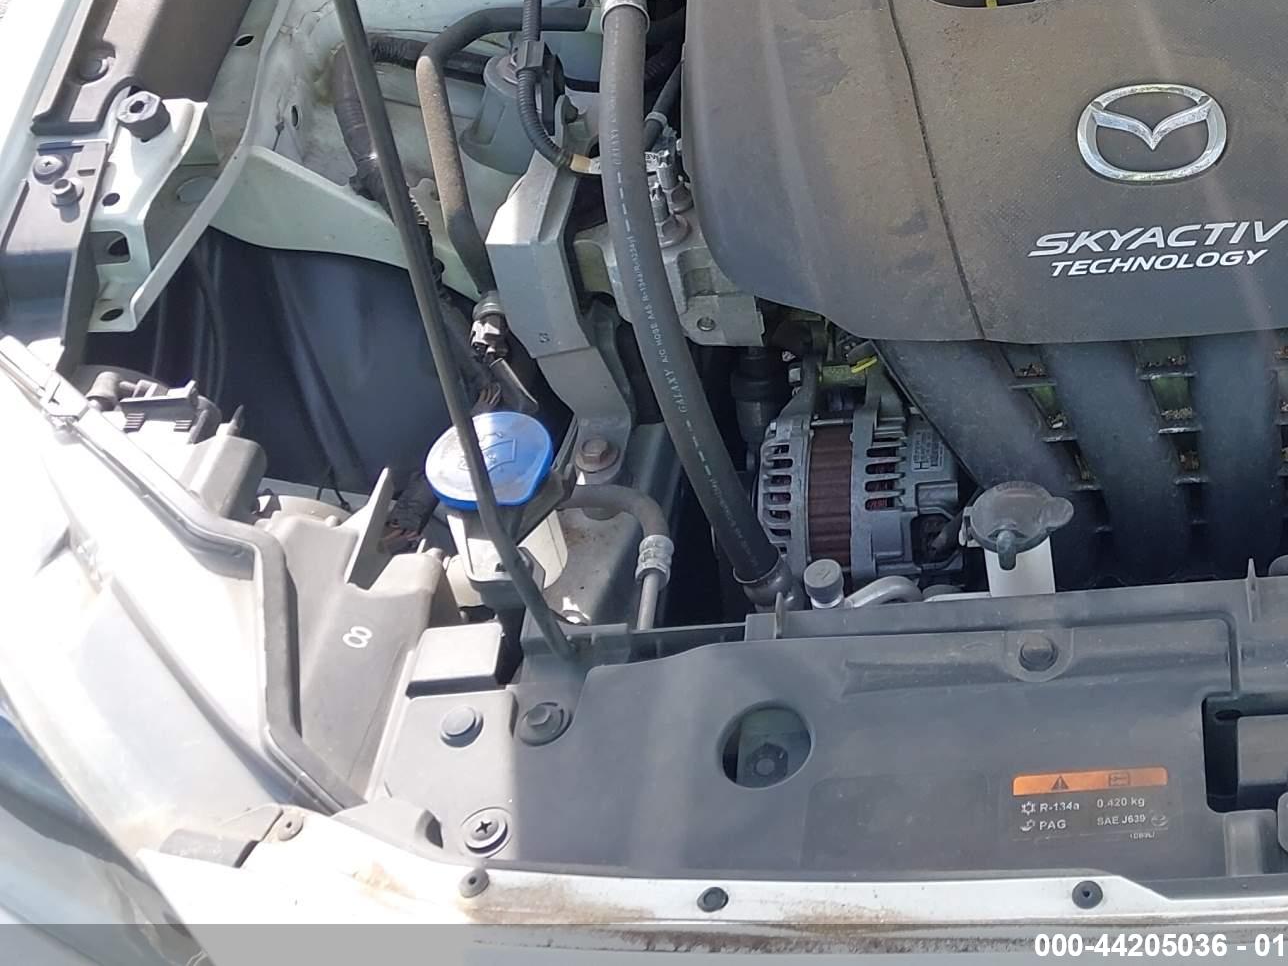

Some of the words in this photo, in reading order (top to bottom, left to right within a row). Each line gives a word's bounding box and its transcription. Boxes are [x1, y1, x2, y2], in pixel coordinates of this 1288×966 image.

[1050, 249, 1269, 277] TECHNOLOGY
[342, 625, 373, 649] 8
[1039, 801, 1081, 813] R-134a
[1096, 797, 1128, 809] 0.420
[1130, 796, 1146, 808] kg
[1039, 819, 1067, 831] PAG
[1096, 815, 1119, 826] SAE
[1121, 814, 1146, 825] J639
